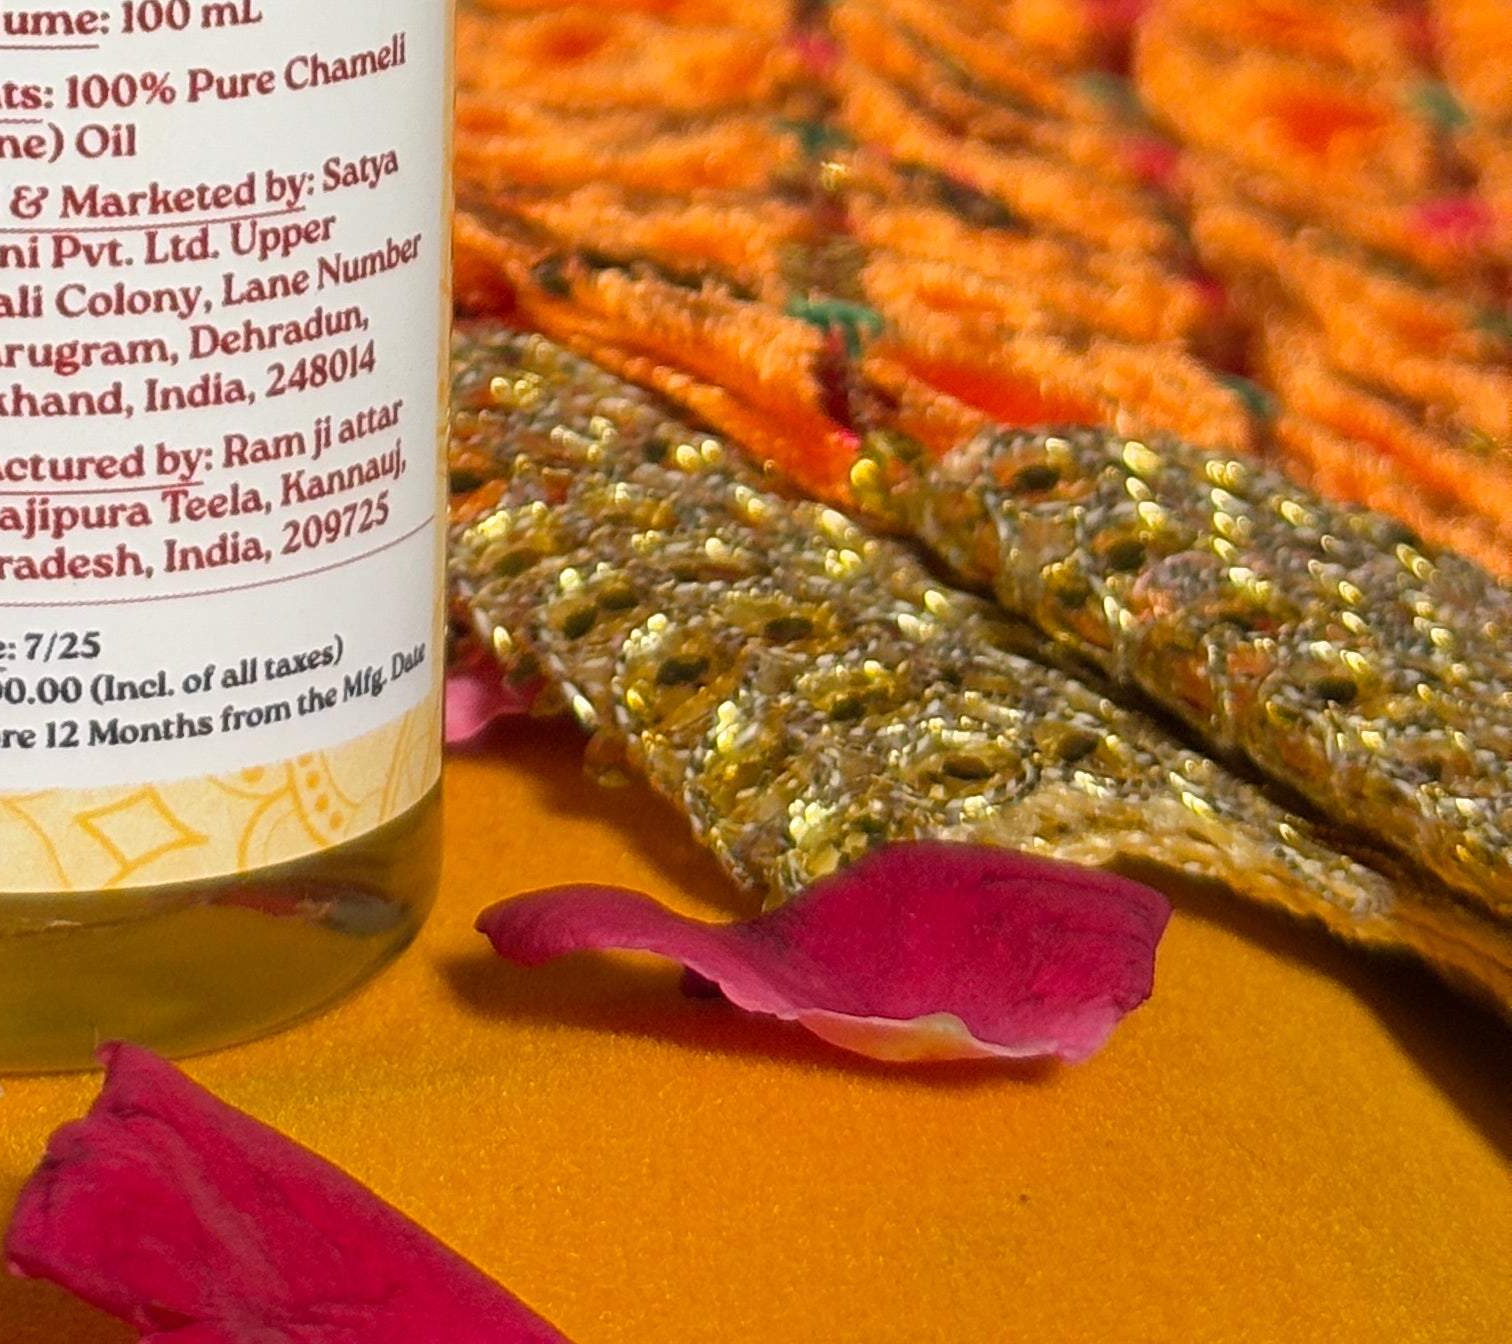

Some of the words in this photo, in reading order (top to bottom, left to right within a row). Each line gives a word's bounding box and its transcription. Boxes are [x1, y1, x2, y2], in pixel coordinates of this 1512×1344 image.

[65, 72, 175, 109] 100%
[187, 68, 275, 103] Pure
[283, 32, 407, 91] Chameli
[75, 123, 136, 157] Oil
[10, 186, 48, 219] &
[59, 174, 255, 218] Marketed
[266, 169, 314, 208] by:
[322, 149, 398, 195] Satya
[53, 235, 133, 269] Pvt.
[144, 224, 218, 266] Ltd.
[231, 213, 335, 261] Upper
[55, 283, 212, 322] Colony,
[223, 266, 309, 306] Lane
[317, 233, 423, 292] Number
[189, 304, 369, 361] Dehradun,
[144, 373, 255, 414] India,
[265, 342, 376, 399] 248014
[156, 441, 214, 482] by:
[223, 432, 306, 469] Ram
[313, 415, 331, 459] ji
[337, 398, 403, 445] attar
[162, 483, 272, 524] Teela,
[280, 440, 407, 508] Kannauj,
[165, 534, 272, 574] India,
[281, 491, 389, 556] 209725
[24, 630, 100, 663] 7/25
[90, 671, 174, 706] (Incl.
[187, 669, 215, 695] of
[221, 652, 259, 686] all
[265, 635, 344, 682] taxes)
[46, 719, 79, 749] 12
[88, 711, 212, 749] Months
[220, 695, 291, 736] from
[297, 681, 337, 715] the
[343, 663, 388, 700] Mfg.
[390, 640, 425, 680] Date
